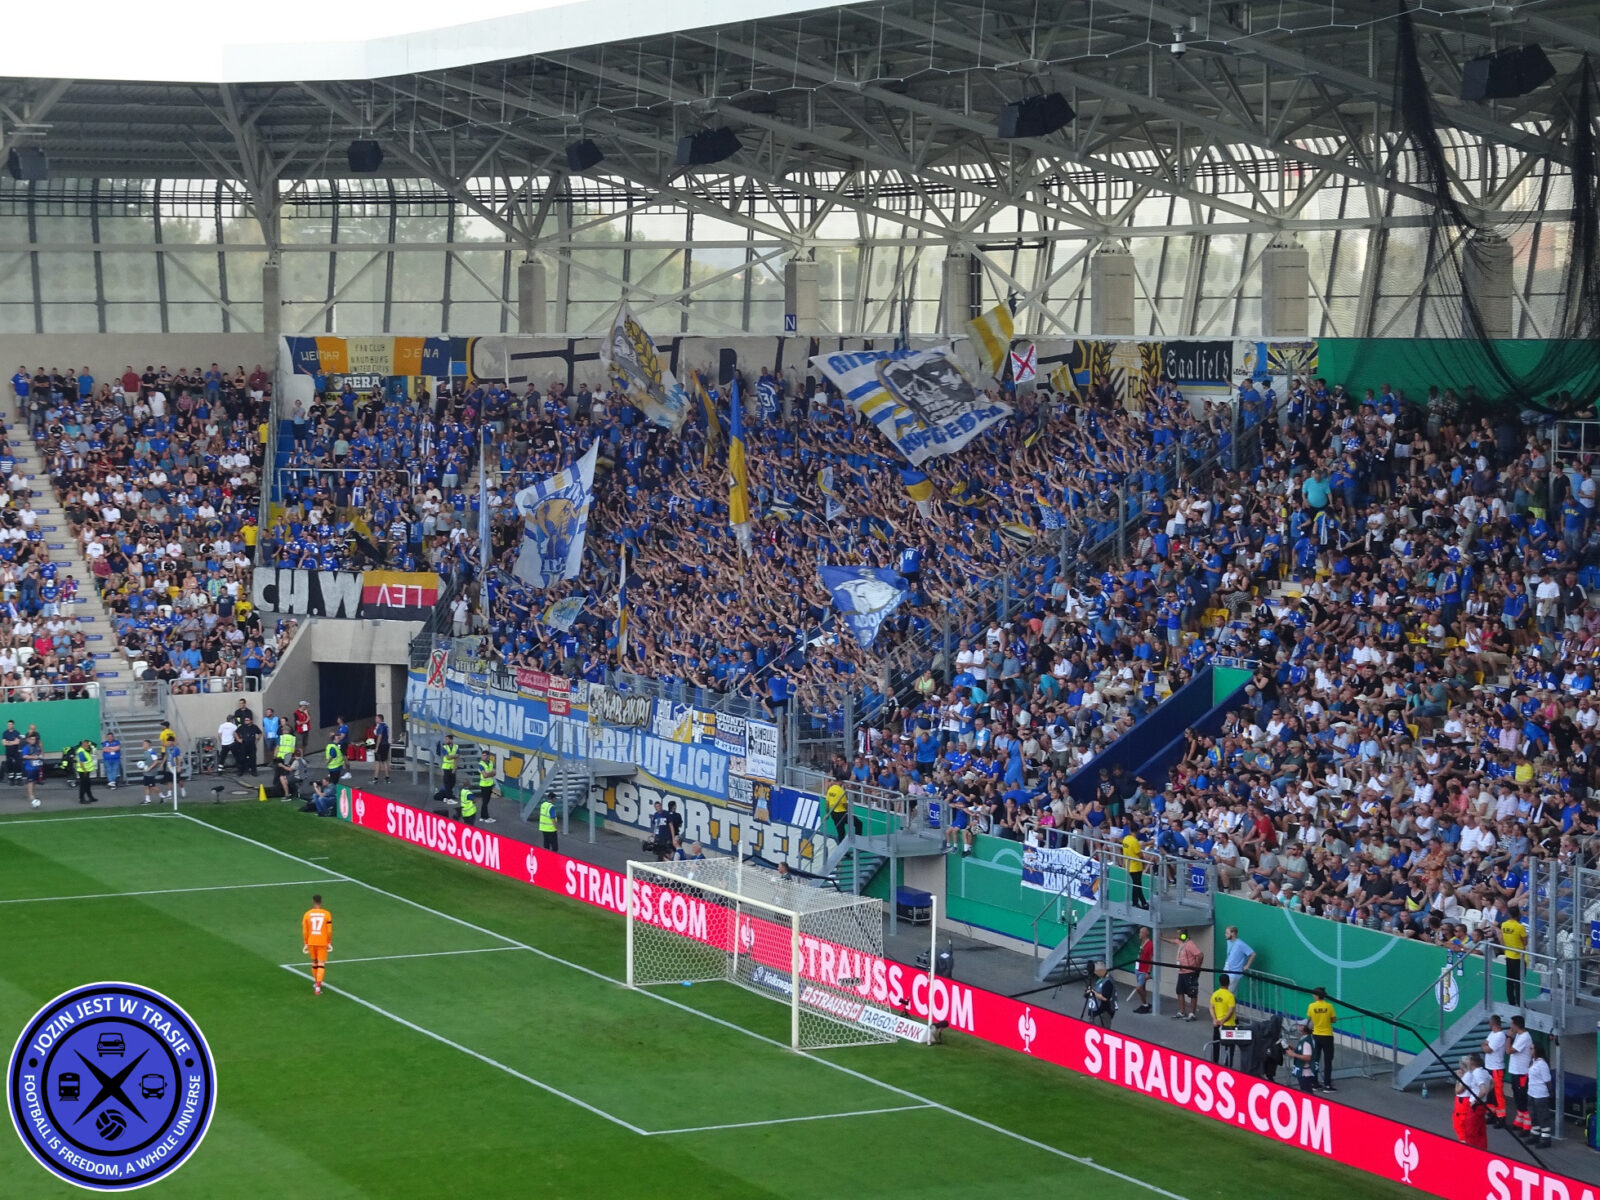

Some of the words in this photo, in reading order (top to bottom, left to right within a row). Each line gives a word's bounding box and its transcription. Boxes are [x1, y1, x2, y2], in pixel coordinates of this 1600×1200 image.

[785, 315, 796, 331] N
[301, 350, 340, 361] WEIMAR
[402, 348, 439, 359] JENA
[344, 376, 382, 388] GERA
[901, 404, 1005, 455] AUFGEBEN
[386, 802, 501, 870] STRAUSS.COM
[1191, 874, 1205, 887] C17
[565, 859, 708, 941] STRAUSS.COM
[310, 917, 325, 931] 17
[1084, 1028, 1332, 1154] STRAUSS.COM
